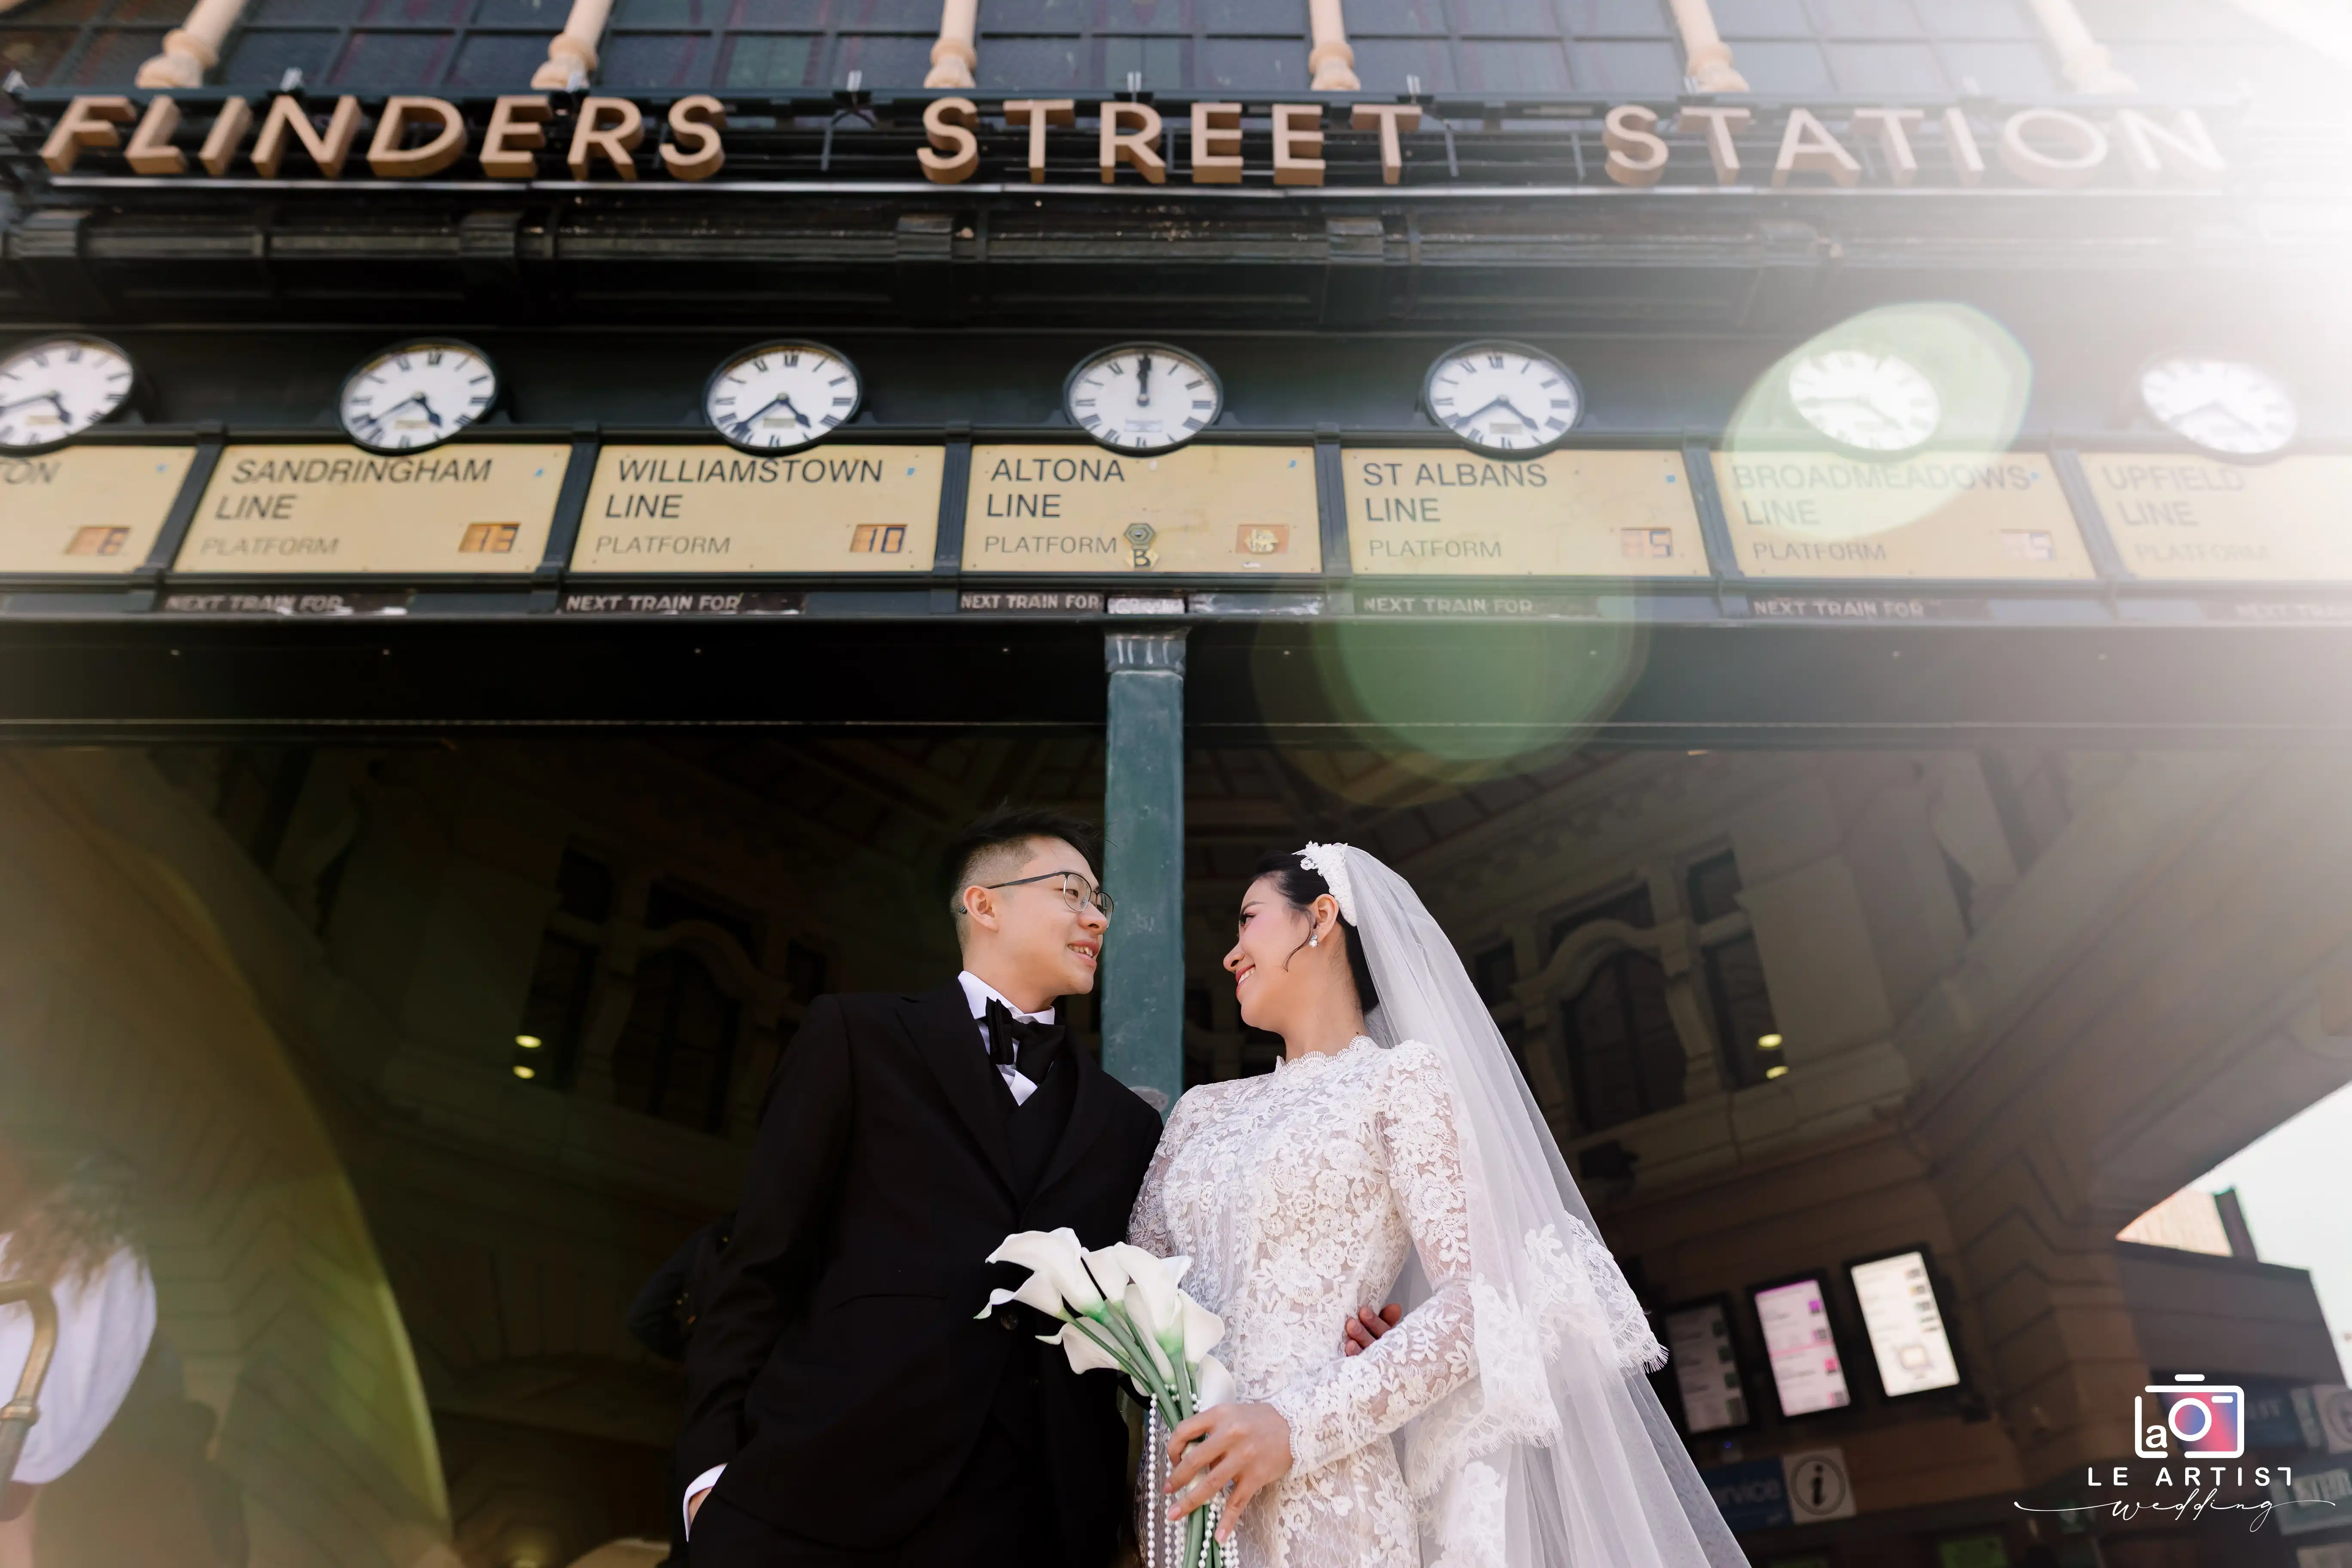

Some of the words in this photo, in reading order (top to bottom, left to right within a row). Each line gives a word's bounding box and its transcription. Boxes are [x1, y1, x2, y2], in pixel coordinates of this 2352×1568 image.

[40, 94, 726, 181] FLINDERS
[916, 96, 1422, 187] STREET
[1601, 104, 2226, 187] STATION
[231, 457, 492, 484] SANDRINGHAM
[618, 458, 884, 483] WILLIAMSTOWN
[991, 459, 1125, 482] ALTONA
[1363, 462, 1402, 487] ST
[1415, 462, 1547, 487] ALBANS
[1732, 464, 2030, 491] BROADMEADOWS
[2102, 465, 2246, 491] UPFIELD
[214, 494, 297, 520] LINE
[605, 494, 683, 518] LINE
[987, 494, 1061, 518] LINE
[1365, 498, 1441, 522] LINE
[1742, 500, 1820, 526] LINE
[2116, 501, 2199, 527] LINE
[200, 536, 340, 555] PLATFORM
[596, 536, 731, 554] PLATFORM
[869, 527, 905, 553] 10
[985, 536, 1116, 553] PLATFORM
[1369, 539, 1501, 558] PLATFORM
[1753, 542, 1886, 561] PLATFORM
[566, 595, 622, 611] NEXT
[628, 595, 693, 611] TRAIN
[698, 595, 740, 611] FOR
[960, 594, 1001, 609] NEXT
[1006, 594, 1058, 609] TRAIN
[1065, 594, 1099, 609] FOR
[1363, 597, 1415, 613] NEXT
[1422, 597, 1488, 614] TRAIN
[1493, 598, 1532, 614] FOR
[1753, 601, 1804, 616] NEXT
